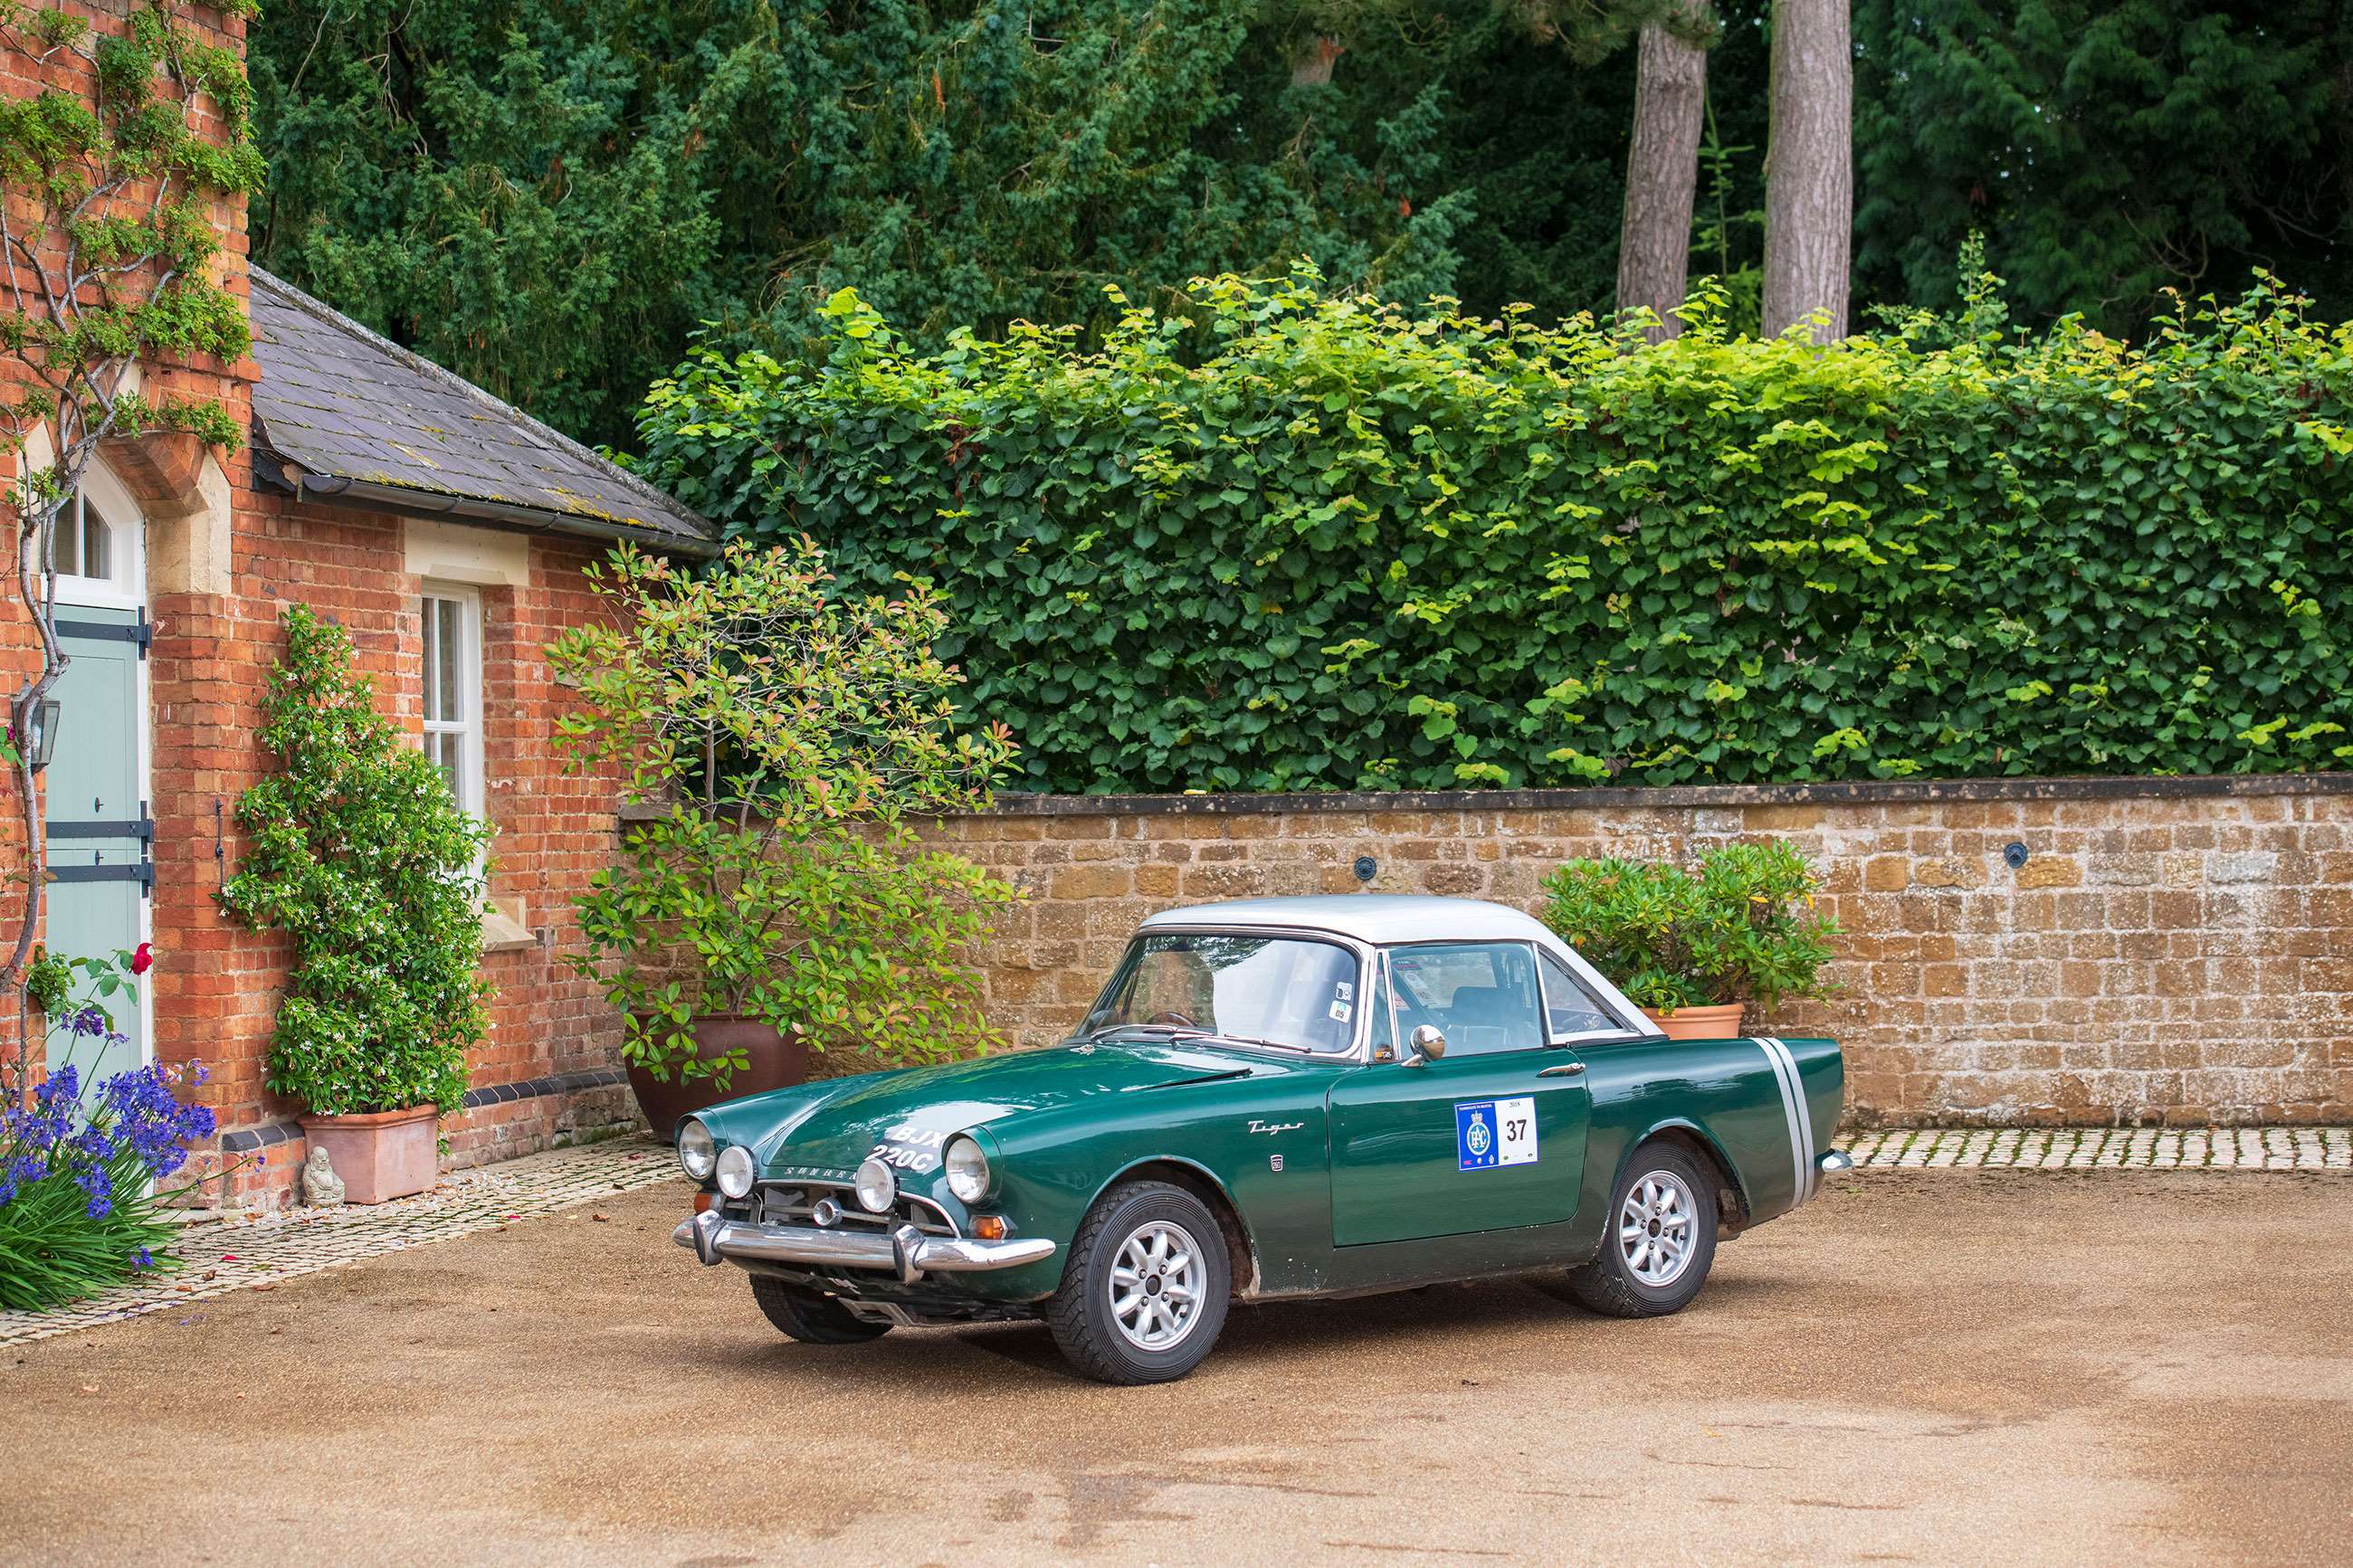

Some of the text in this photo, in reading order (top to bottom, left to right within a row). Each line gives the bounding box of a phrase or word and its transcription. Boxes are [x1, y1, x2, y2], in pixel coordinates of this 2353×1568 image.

[890, 1126, 946, 1149] BJX
[1247, 1119, 1304, 1136] Tiger
[1471, 1126, 1487, 1149] RAC
[1506, 1118, 1527, 1142] 37
[863, 1144, 934, 1171] 220C
[784, 1166, 857, 1181] SUNBEA
